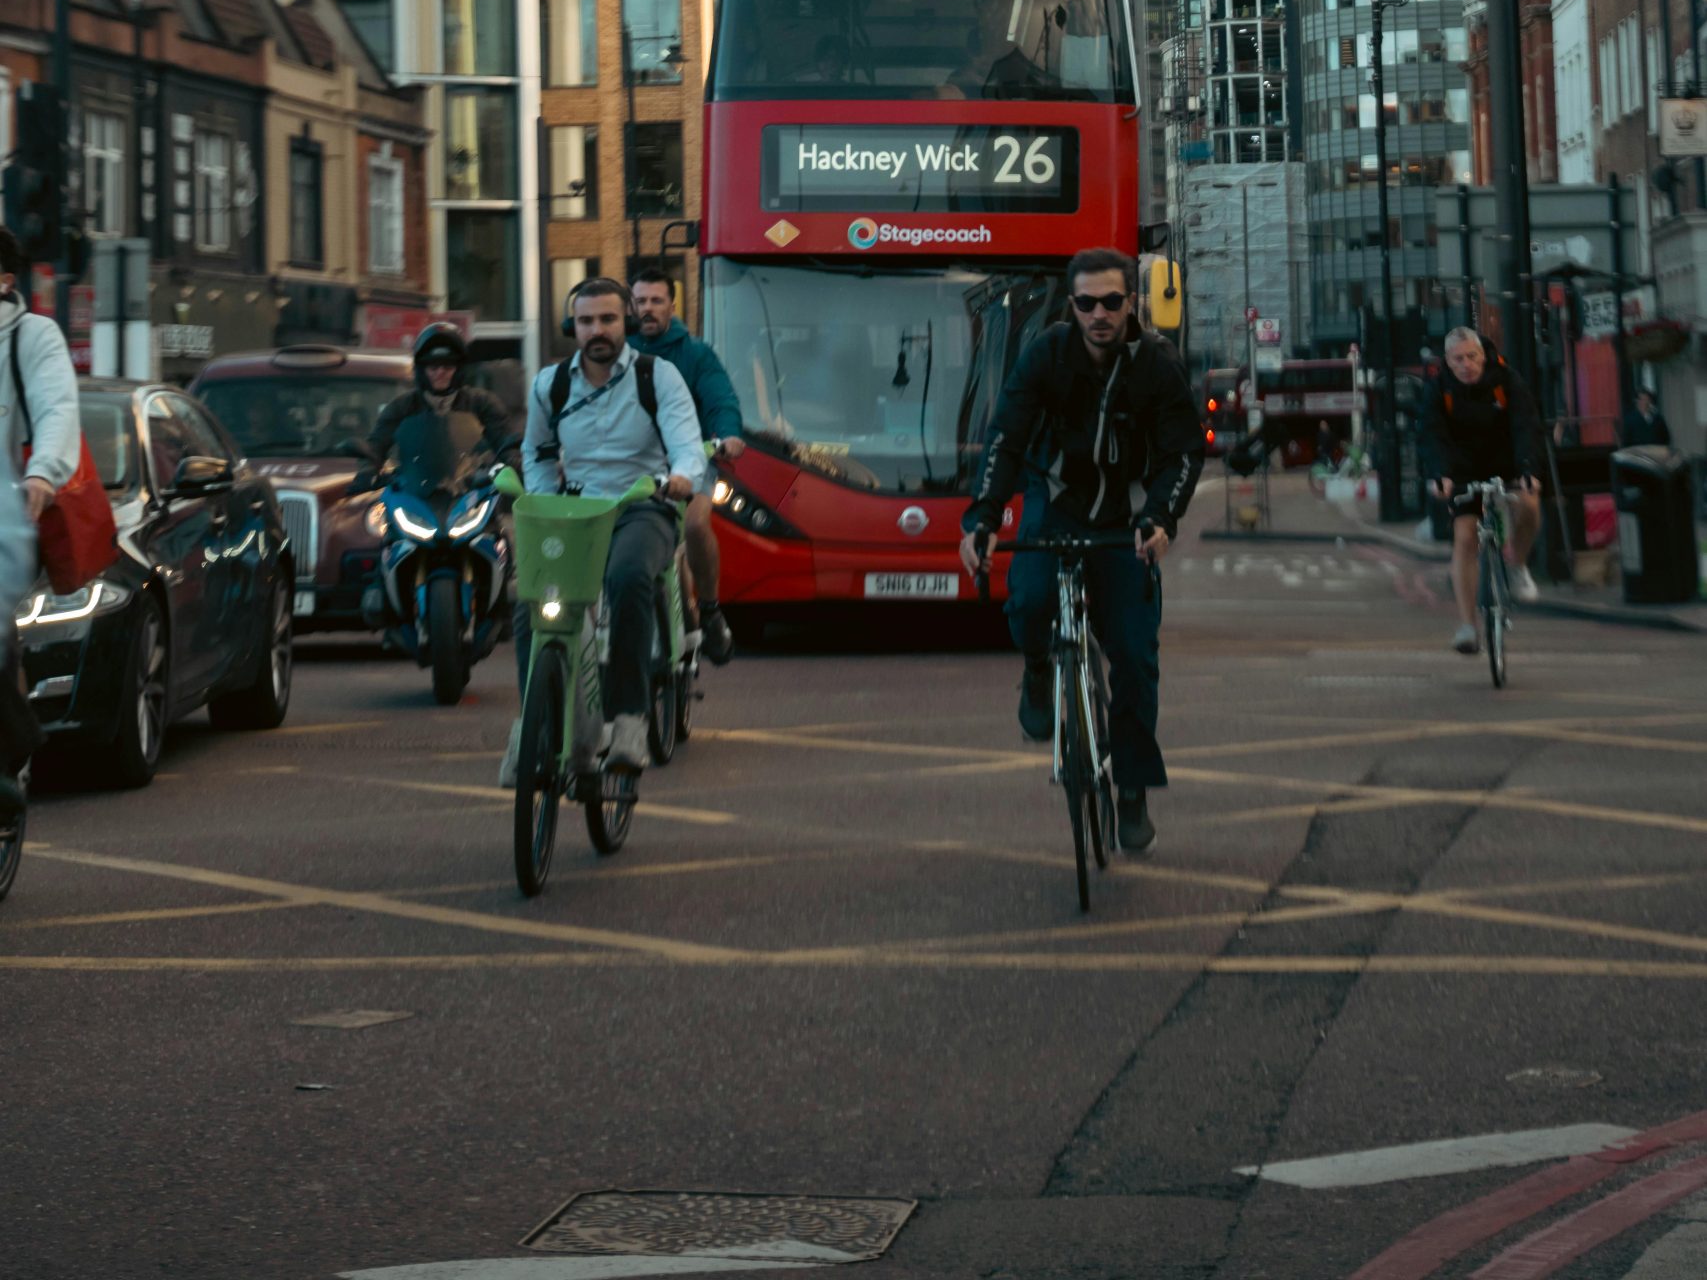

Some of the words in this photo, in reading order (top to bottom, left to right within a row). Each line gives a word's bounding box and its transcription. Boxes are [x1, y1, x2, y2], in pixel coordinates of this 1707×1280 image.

[799, 143, 907, 178] Hackney
[915, 144, 979, 171] Wick
[994, 135, 1055, 183] 26
[879, 223, 992, 246] Stagecoach
